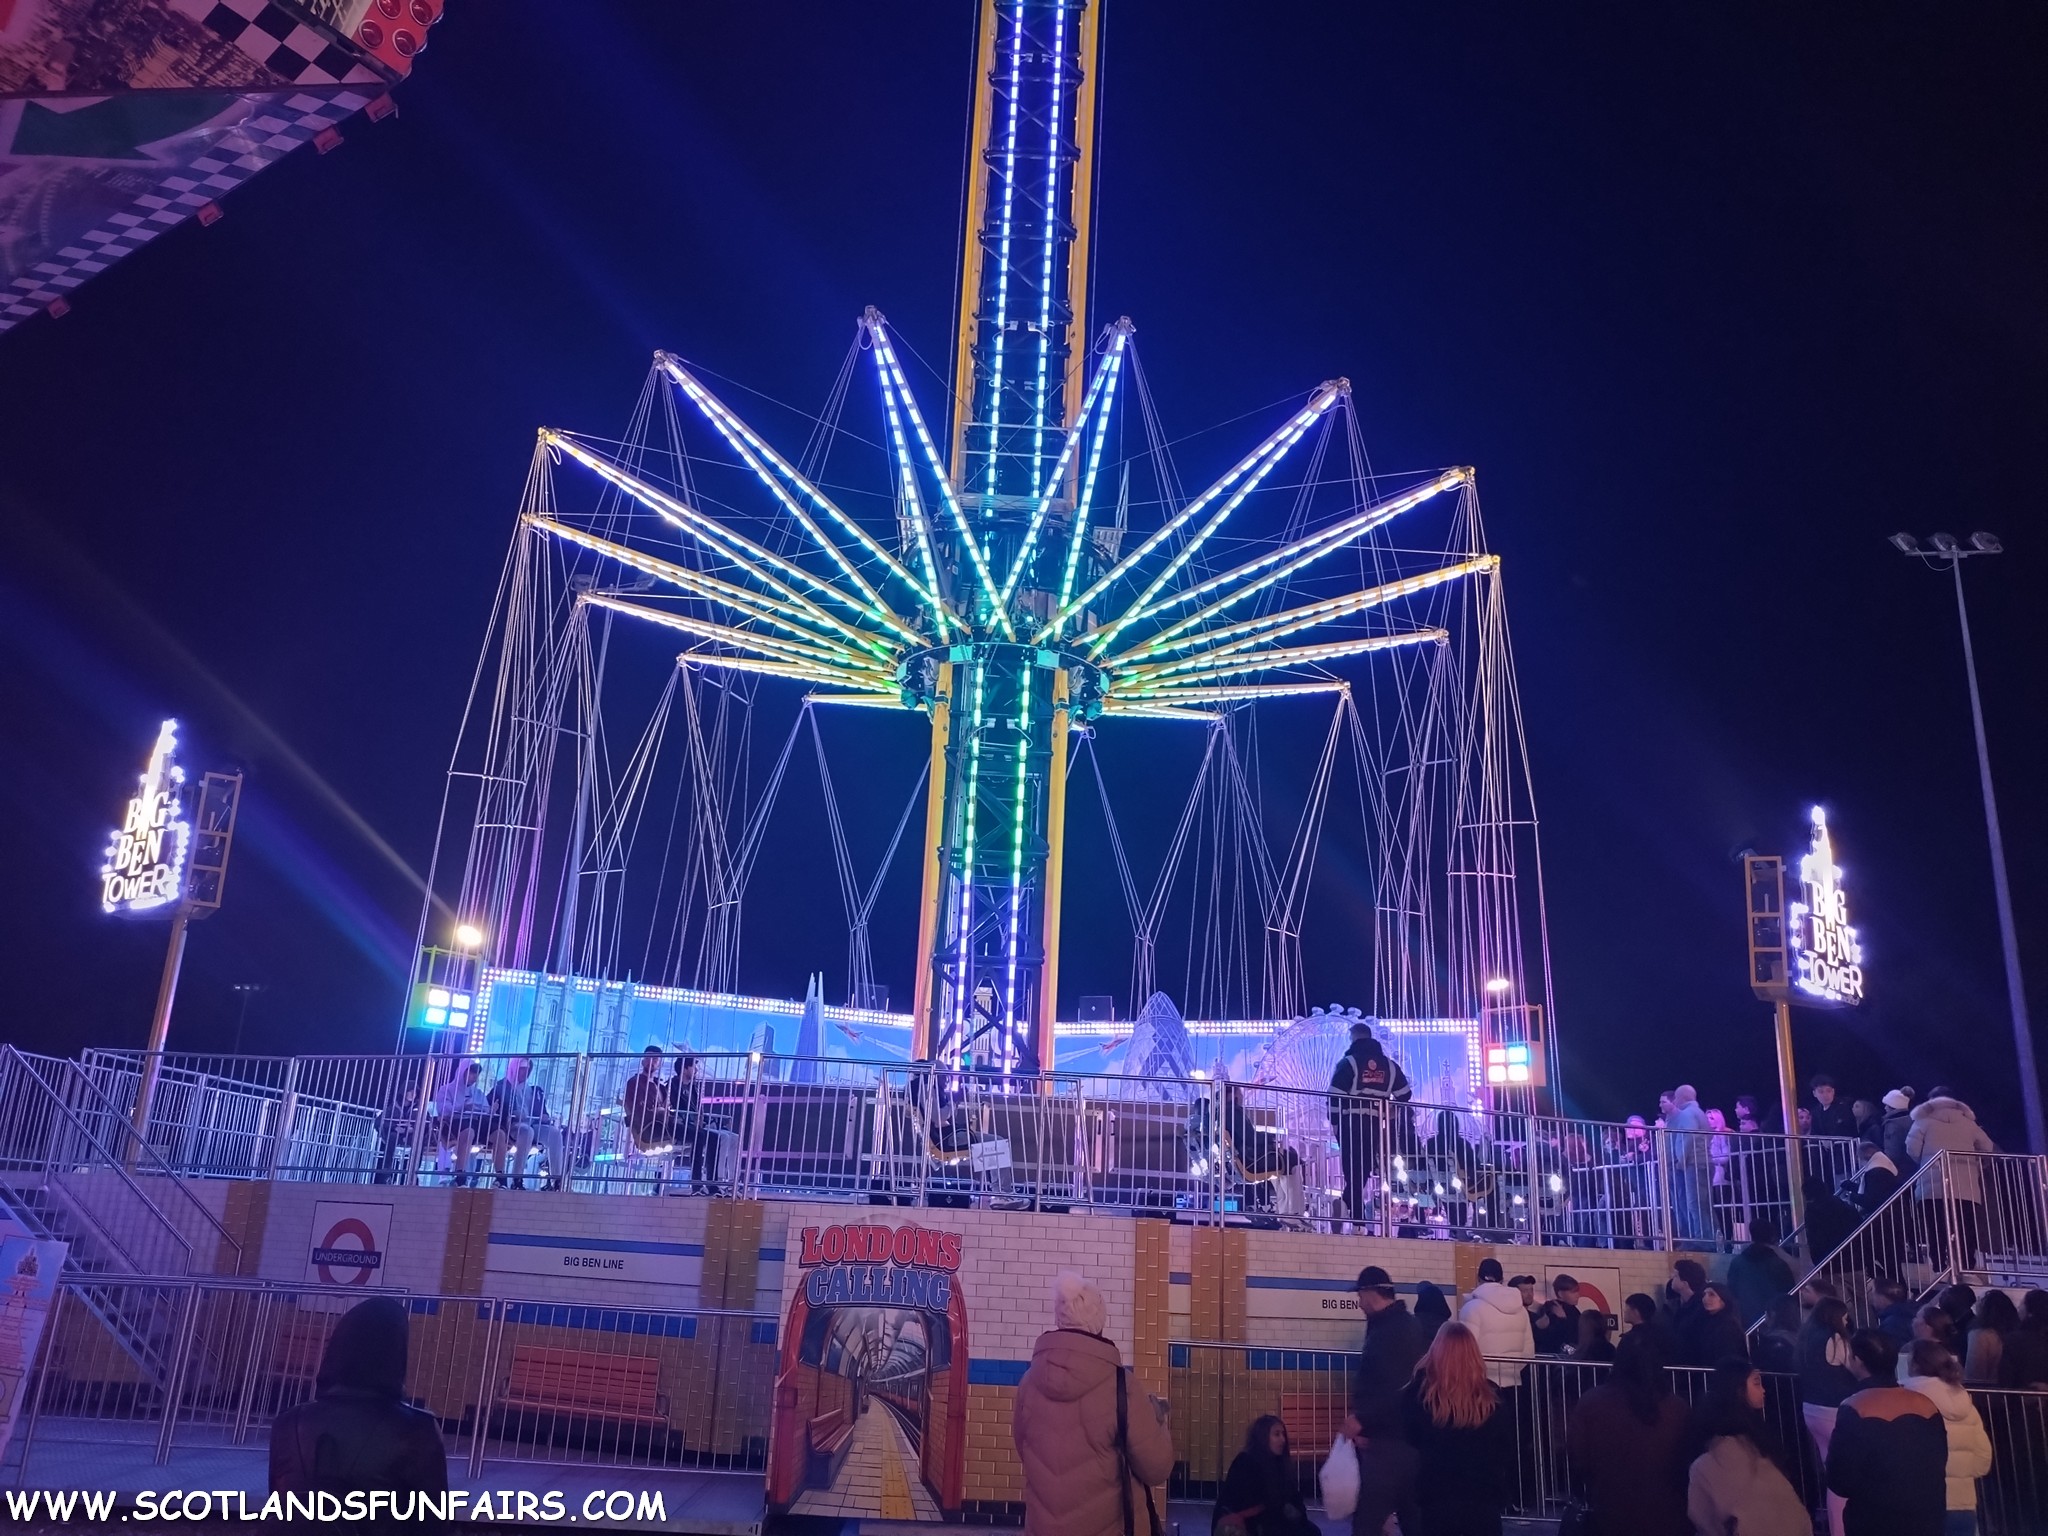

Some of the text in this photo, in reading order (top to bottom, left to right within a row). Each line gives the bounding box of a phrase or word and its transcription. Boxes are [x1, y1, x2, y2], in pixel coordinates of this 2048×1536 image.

[124, 792, 169, 833] BIG
[115, 829, 165, 877] BEN
[102, 863, 171, 903] TOWER
[1811, 881, 1847, 926] BIG
[1810, 917, 1852, 967] BEN
[1804, 950, 1863, 998] TOWER
[315, 1252, 378, 1265] UNDERGROUND
[563, 1256, 624, 1270] BIG BEN LINE
[799, 1225, 962, 1274] LONDONS
[805, 1266, 952, 1315] CALLING
[1322, 1299, 1358, 1309] BIG BEN
